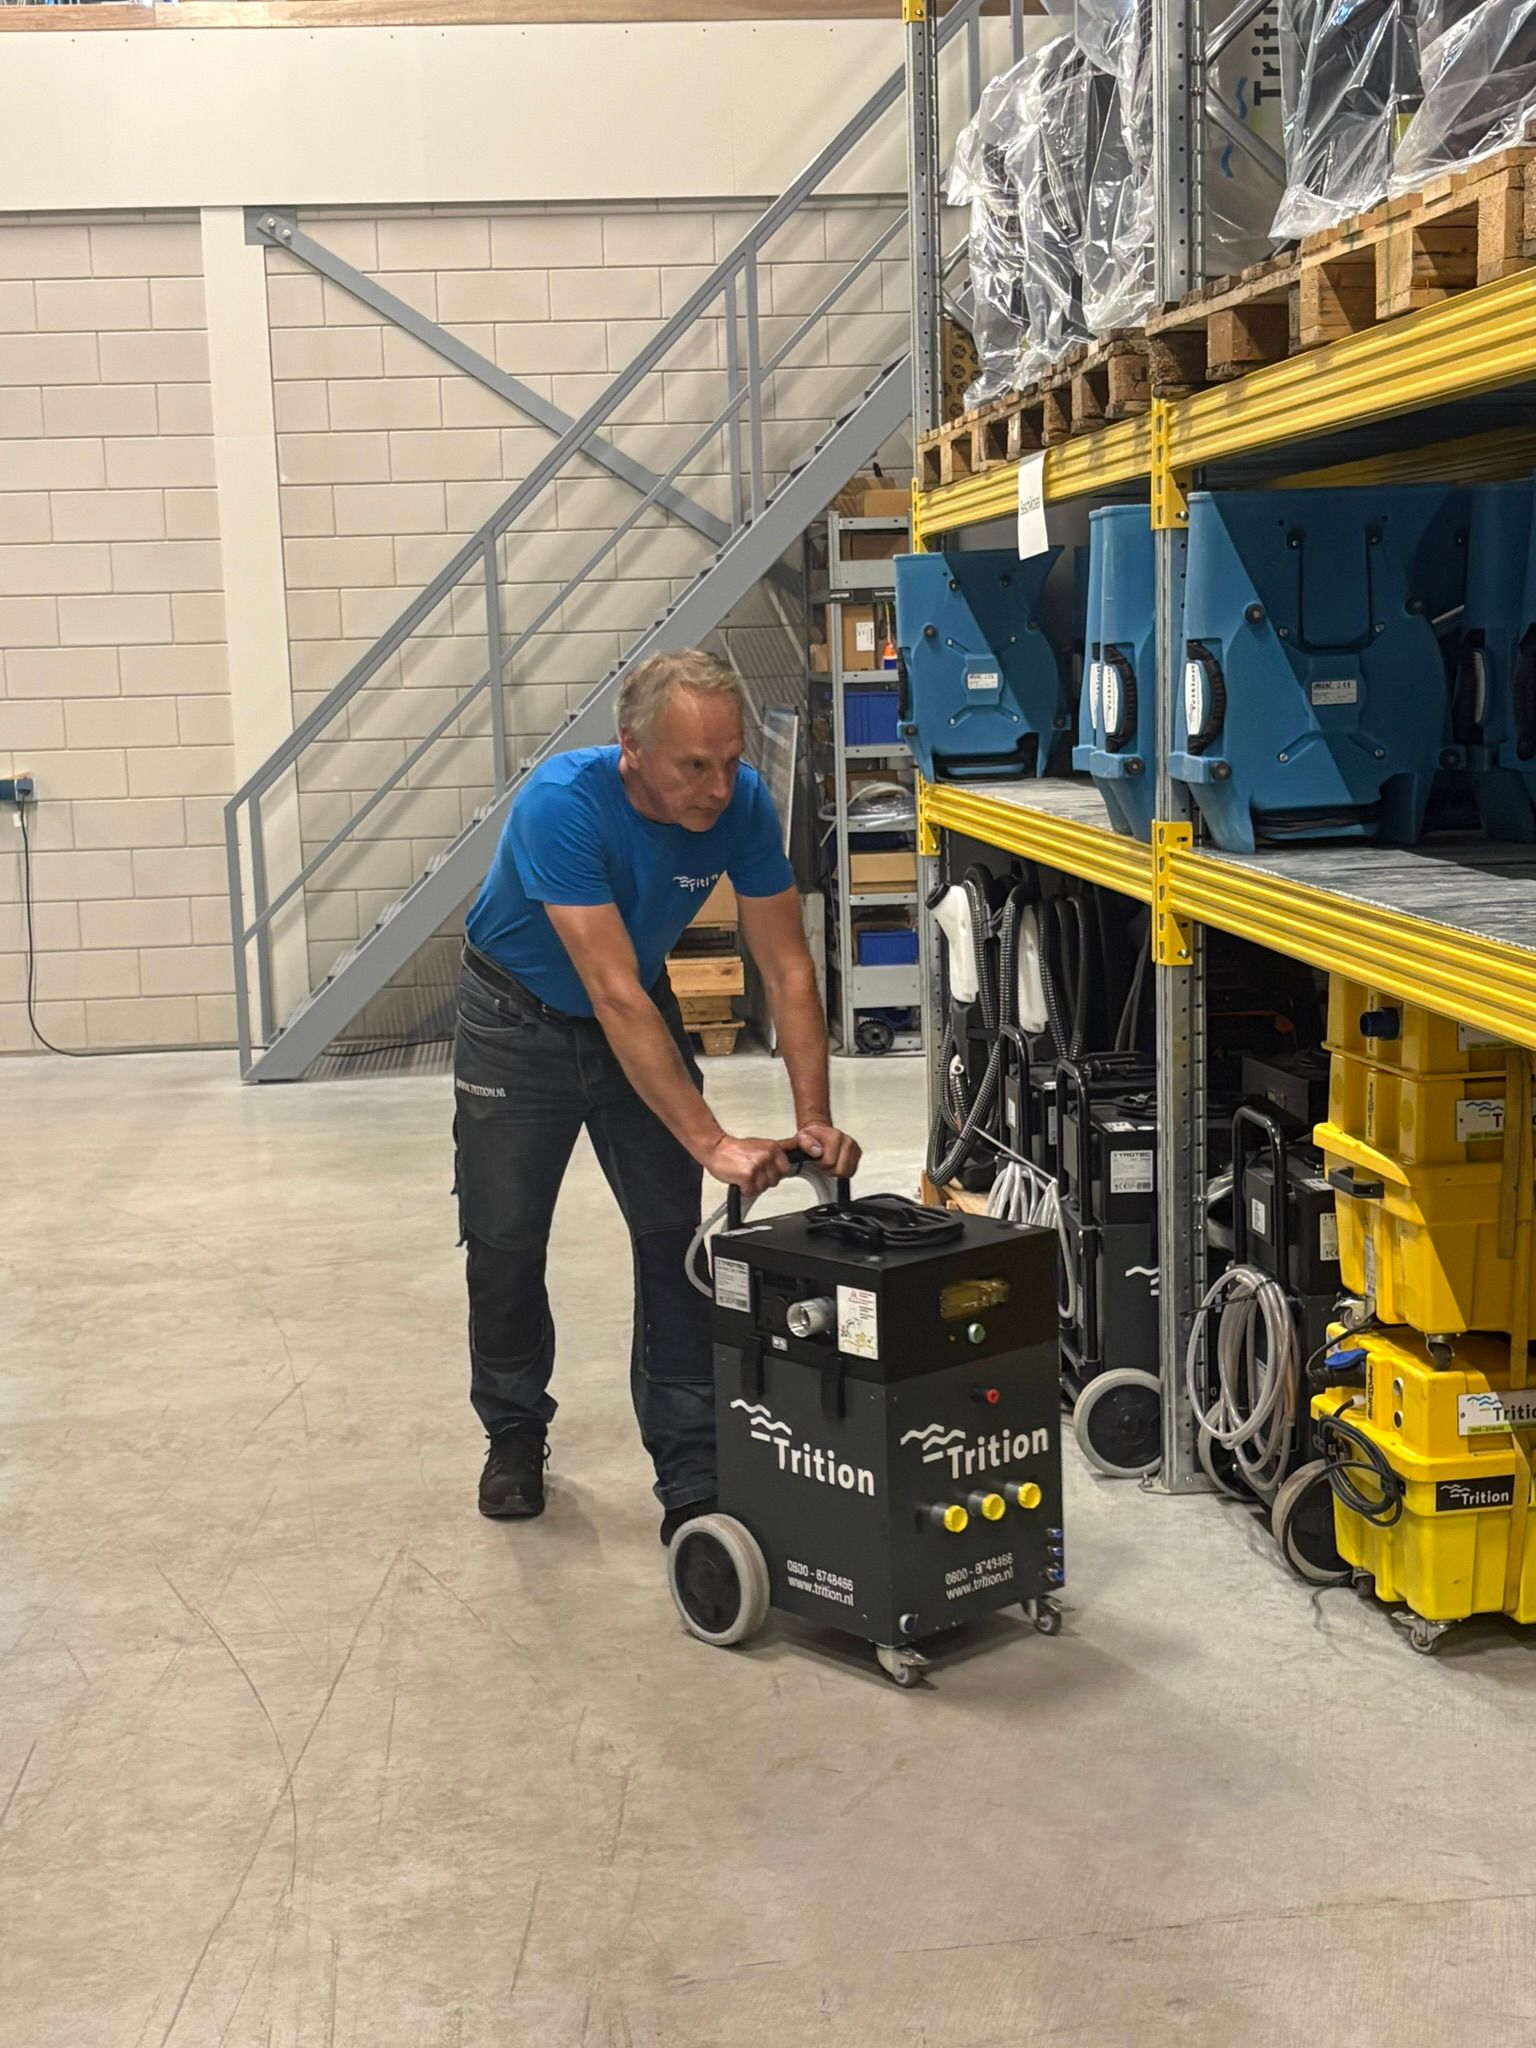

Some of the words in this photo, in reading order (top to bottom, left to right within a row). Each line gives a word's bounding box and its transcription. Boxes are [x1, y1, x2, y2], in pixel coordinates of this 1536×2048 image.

[773, 1436, 875, 1497] Trition
[947, 1427, 1049, 1480] Trition
[1461, 1489, 1510, 1506] Trition
[787, 1575, 855, 1607] www.trition.nl
[945, 1565, 1014, 1601] www.trition.nl
